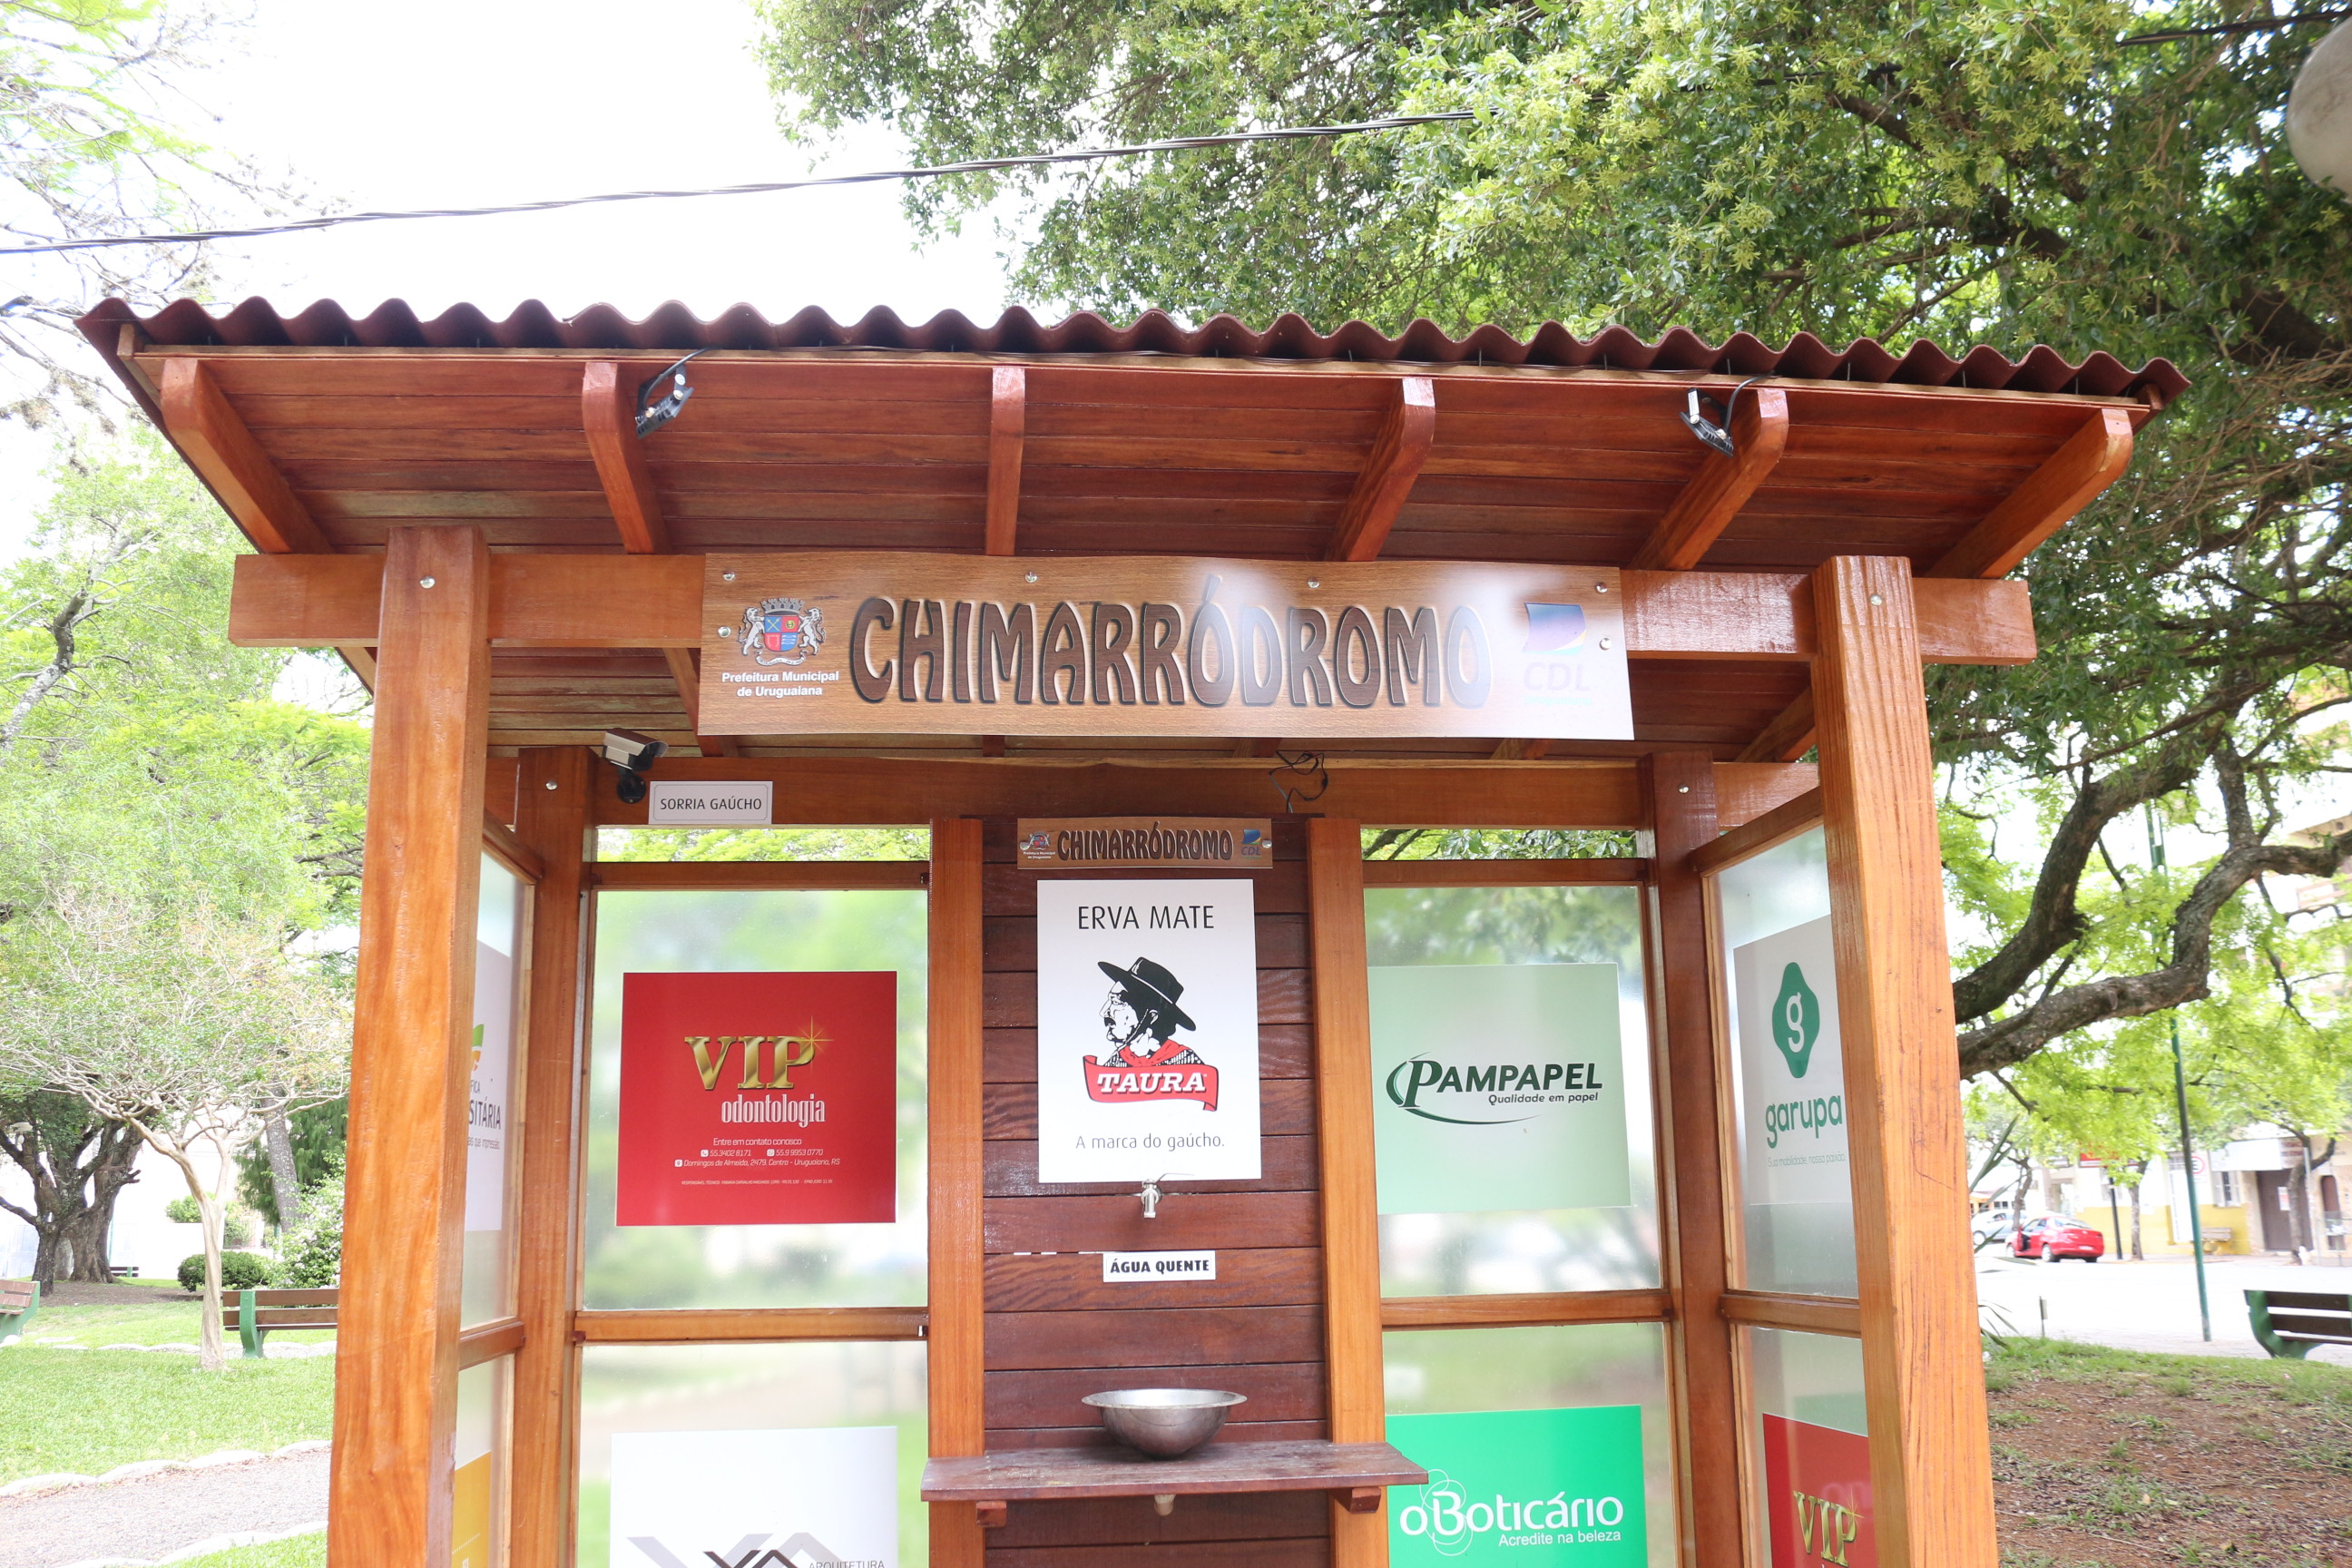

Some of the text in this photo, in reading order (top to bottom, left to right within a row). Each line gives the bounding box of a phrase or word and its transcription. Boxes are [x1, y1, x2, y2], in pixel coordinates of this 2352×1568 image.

[849, 573, 1493, 708] CHIMARRÓDROMO
[721, 671, 839, 683] Prefeitura Municipal
[737, 686, 823, 698] de Uruguaiana
[660, 796, 762, 810] SORRIA GAÚCHO
[1057, 821, 1234, 860] CHIMARRÓDROMO
[1078, 905, 1215, 930] ERVA MATE
[684, 1035, 816, 1091] VIP
[1096, 1073, 1206, 1094] TAURA
[1398, 1060, 1602, 1108] PAMPAPEL
[1488, 1092, 1599, 1106] Qualidade em papel
[721, 1093, 826, 1128] odontologia
[1765, 1095, 1843, 1149] garupa
[713, 1138, 731, 1146] Entre
[745, 1138, 771, 1146] contato
[1075, 1132, 1225, 1152] A marca do gaúcho.
[683, 1160, 714, 1169] Domingos
[1110, 1258, 1210, 1275] ÁGUA QUENTE
[1498, 1529, 1622, 1547] Acredite na beleza
[1793, 1490, 1857, 1567] VIP
